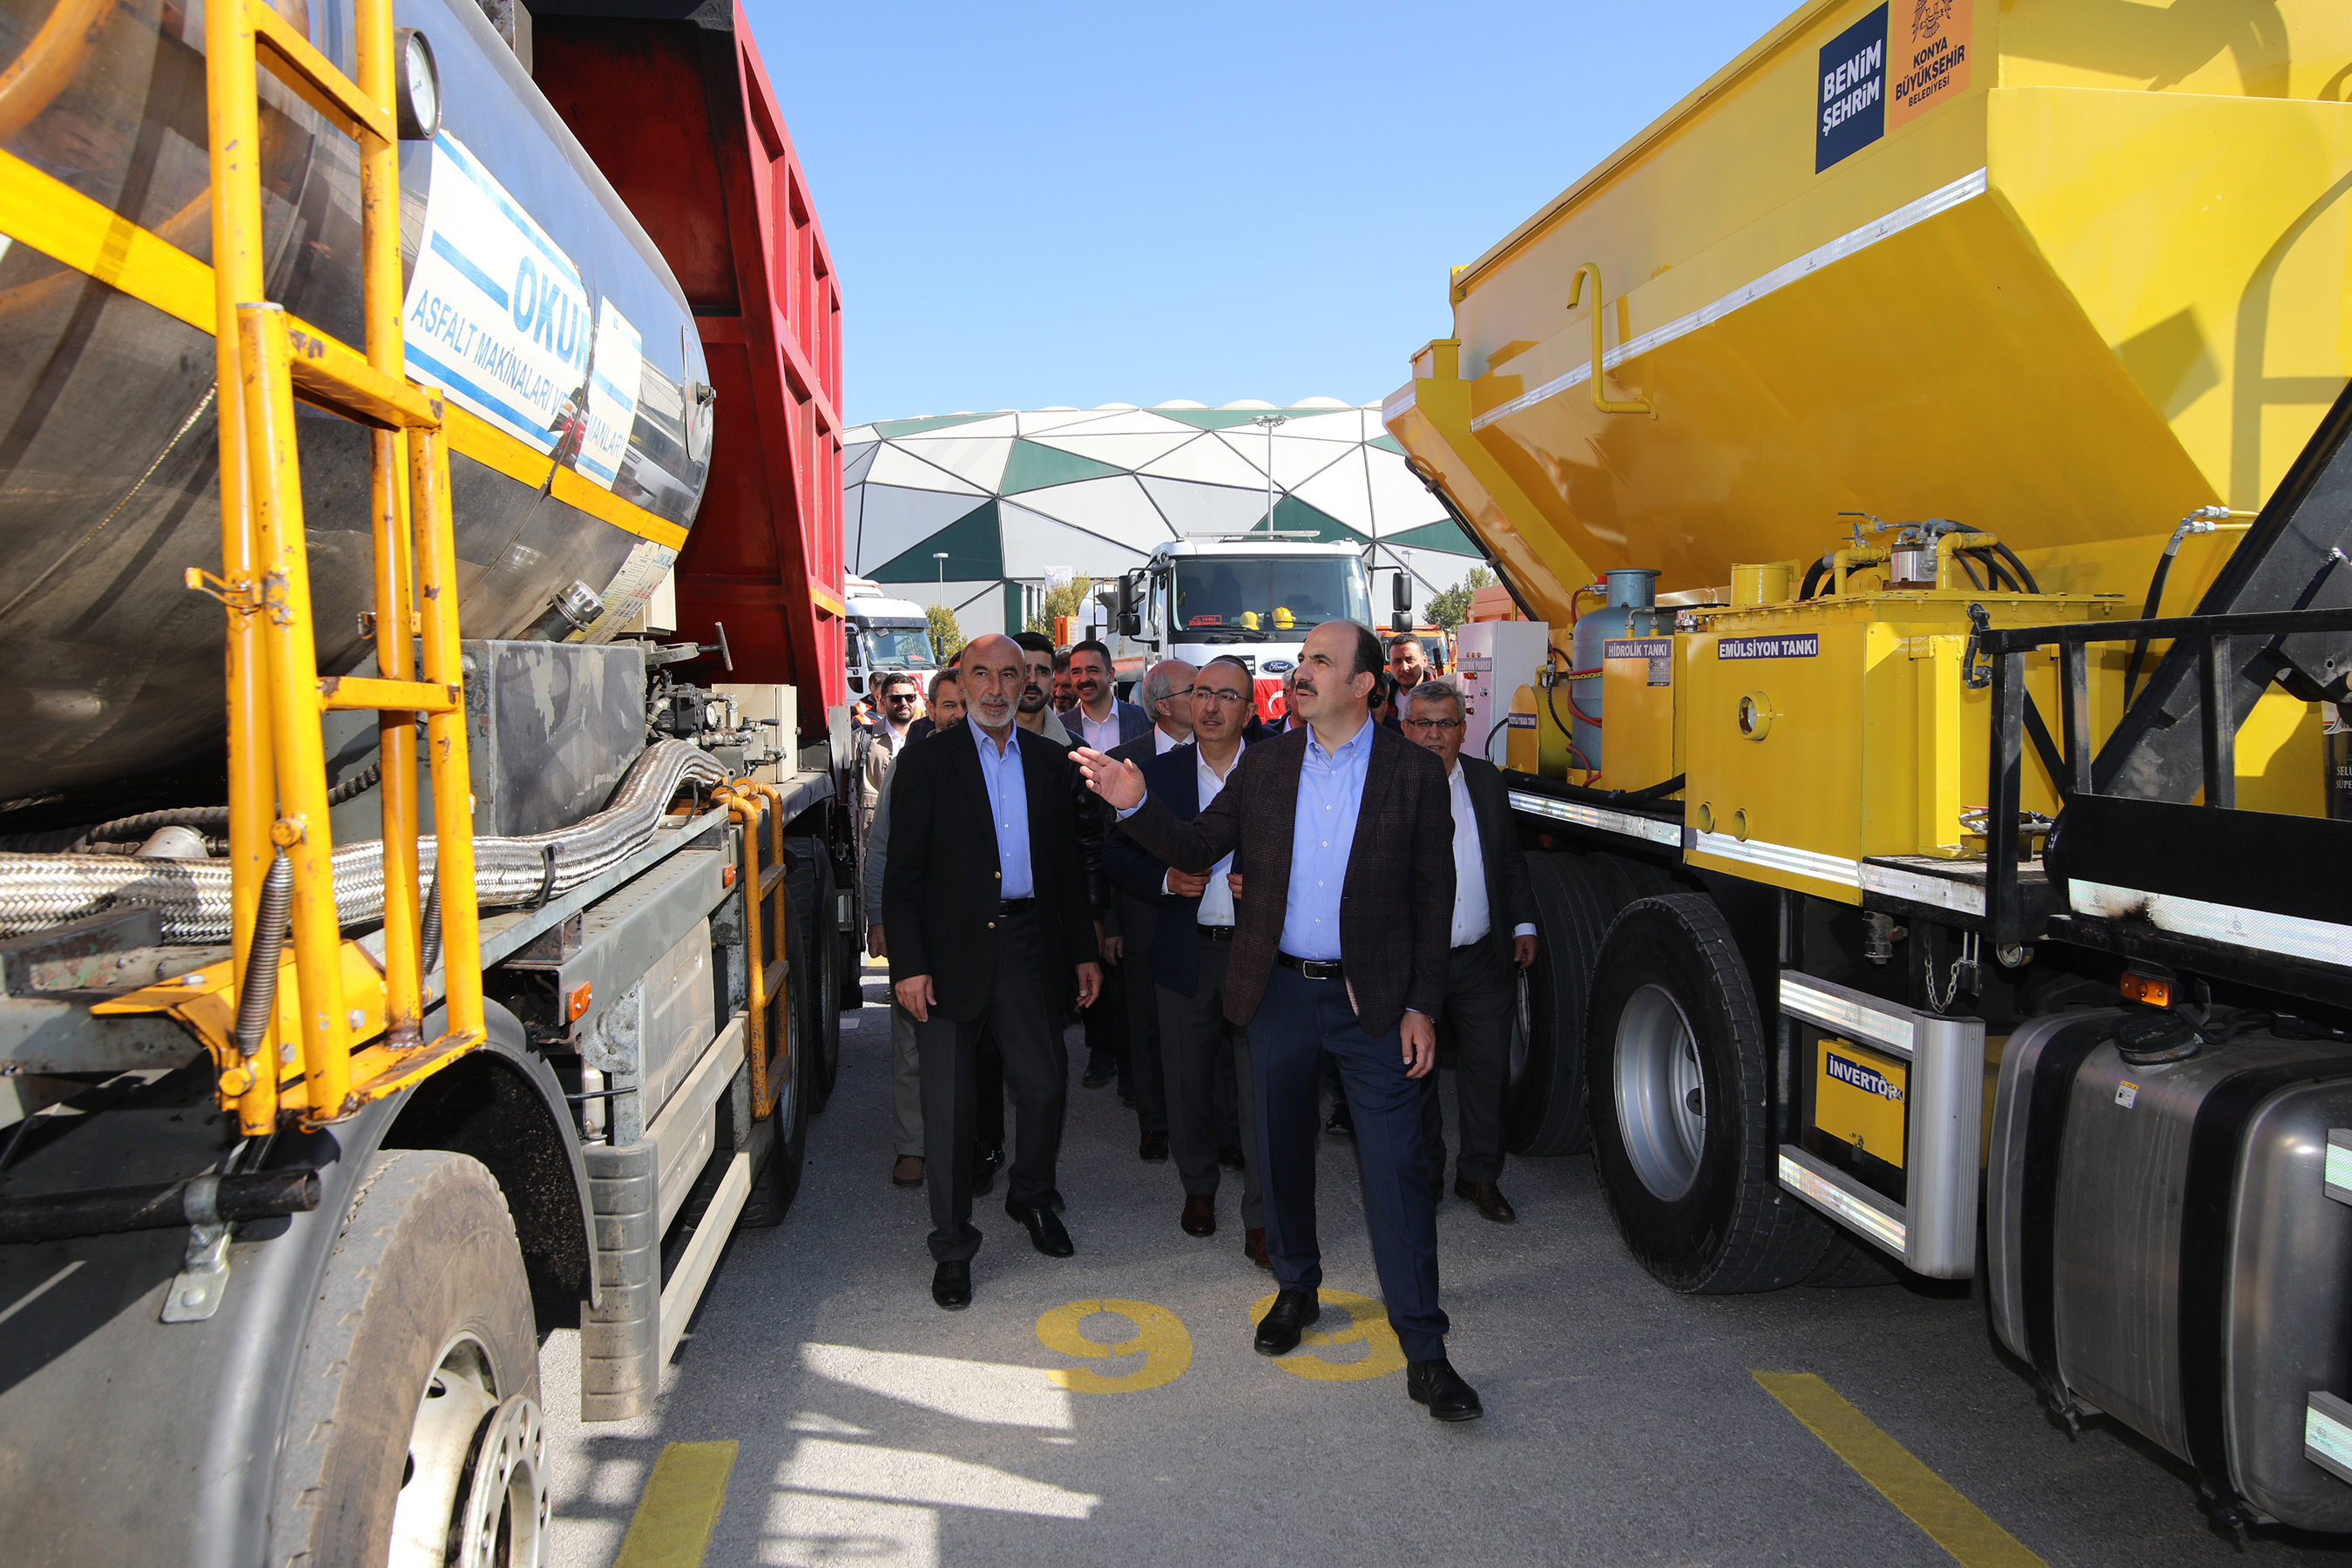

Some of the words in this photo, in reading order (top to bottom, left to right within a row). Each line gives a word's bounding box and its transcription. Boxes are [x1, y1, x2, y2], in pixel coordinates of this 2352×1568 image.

[1913, 37, 1948, 69] KONYA
[1896, 44, 1965, 101] BÜYÜKŞEHİR
[1909, 72, 1950, 107] BELEDİYESİ
[410, 289, 478, 357] ASFALT
[473, 332, 554, 411] MAKİNALARI
[1608, 642, 1642, 657] HİDROLİK
[1643, 644, 1667, 656] TANKI
[1719, 639, 1779, 658] EMÜLSİYON
[1781, 639, 1816, 655] TANKI
[1268, 662, 1289, 671] Ford
